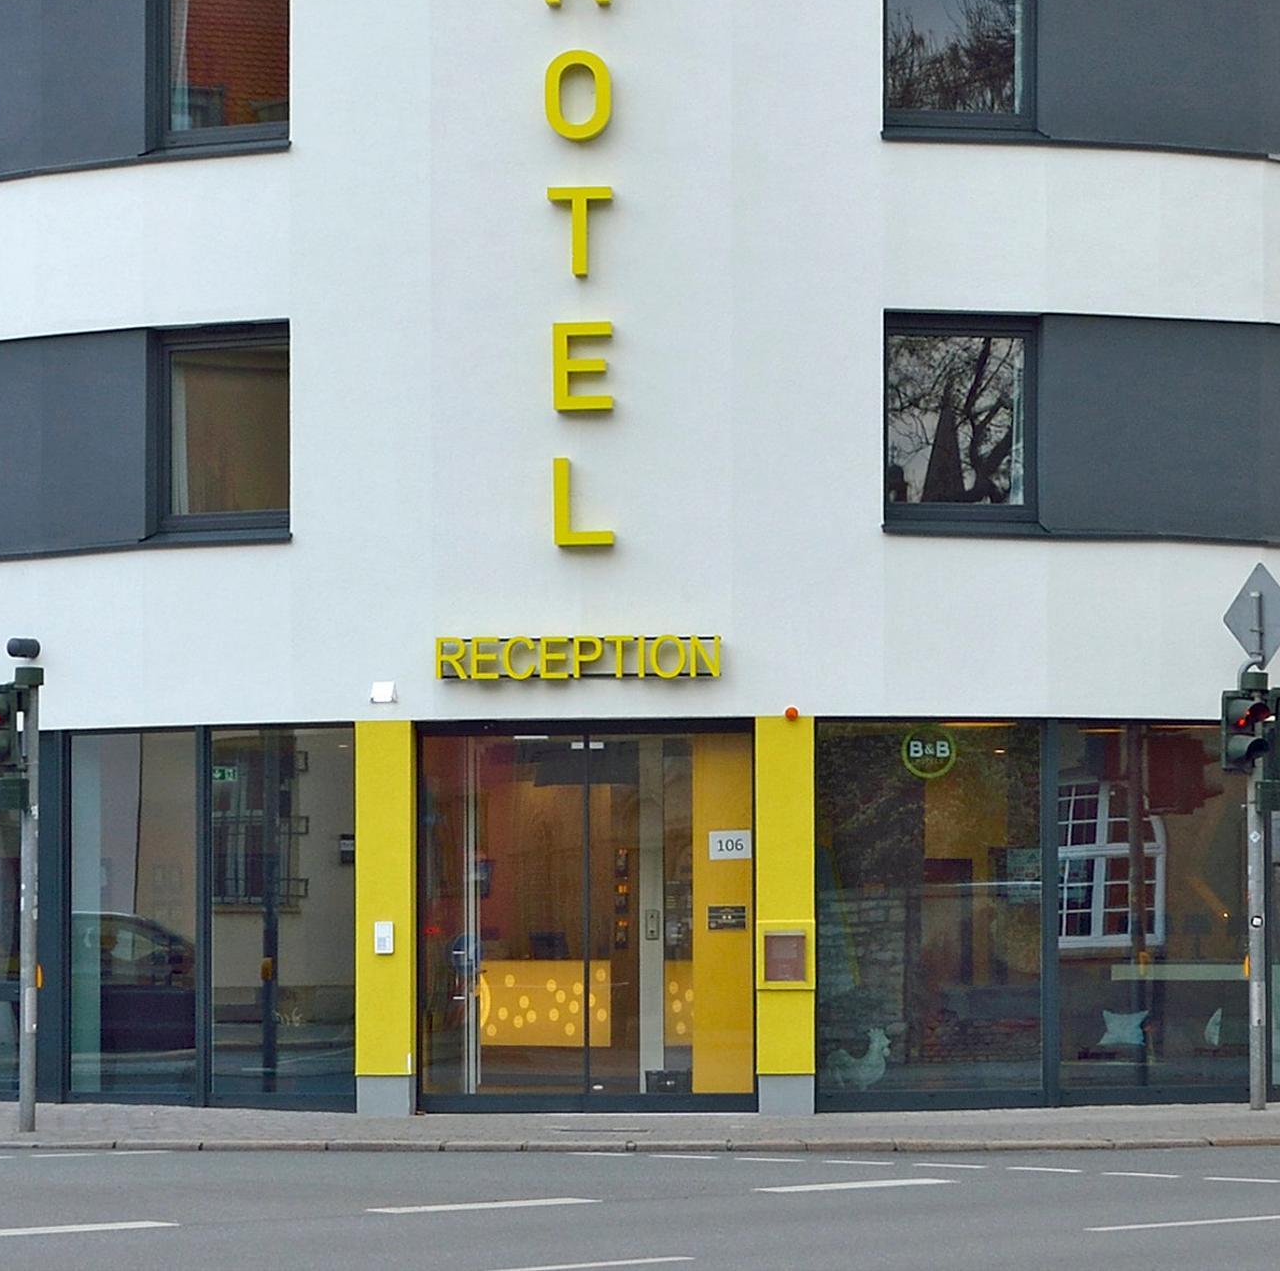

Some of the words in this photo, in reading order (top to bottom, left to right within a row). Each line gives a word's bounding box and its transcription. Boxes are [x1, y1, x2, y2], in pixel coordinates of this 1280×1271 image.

[435, 635, 721, 680] RECEPTION
[910, 740, 950, 758] B&B
[717, 838, 744, 852] 106
